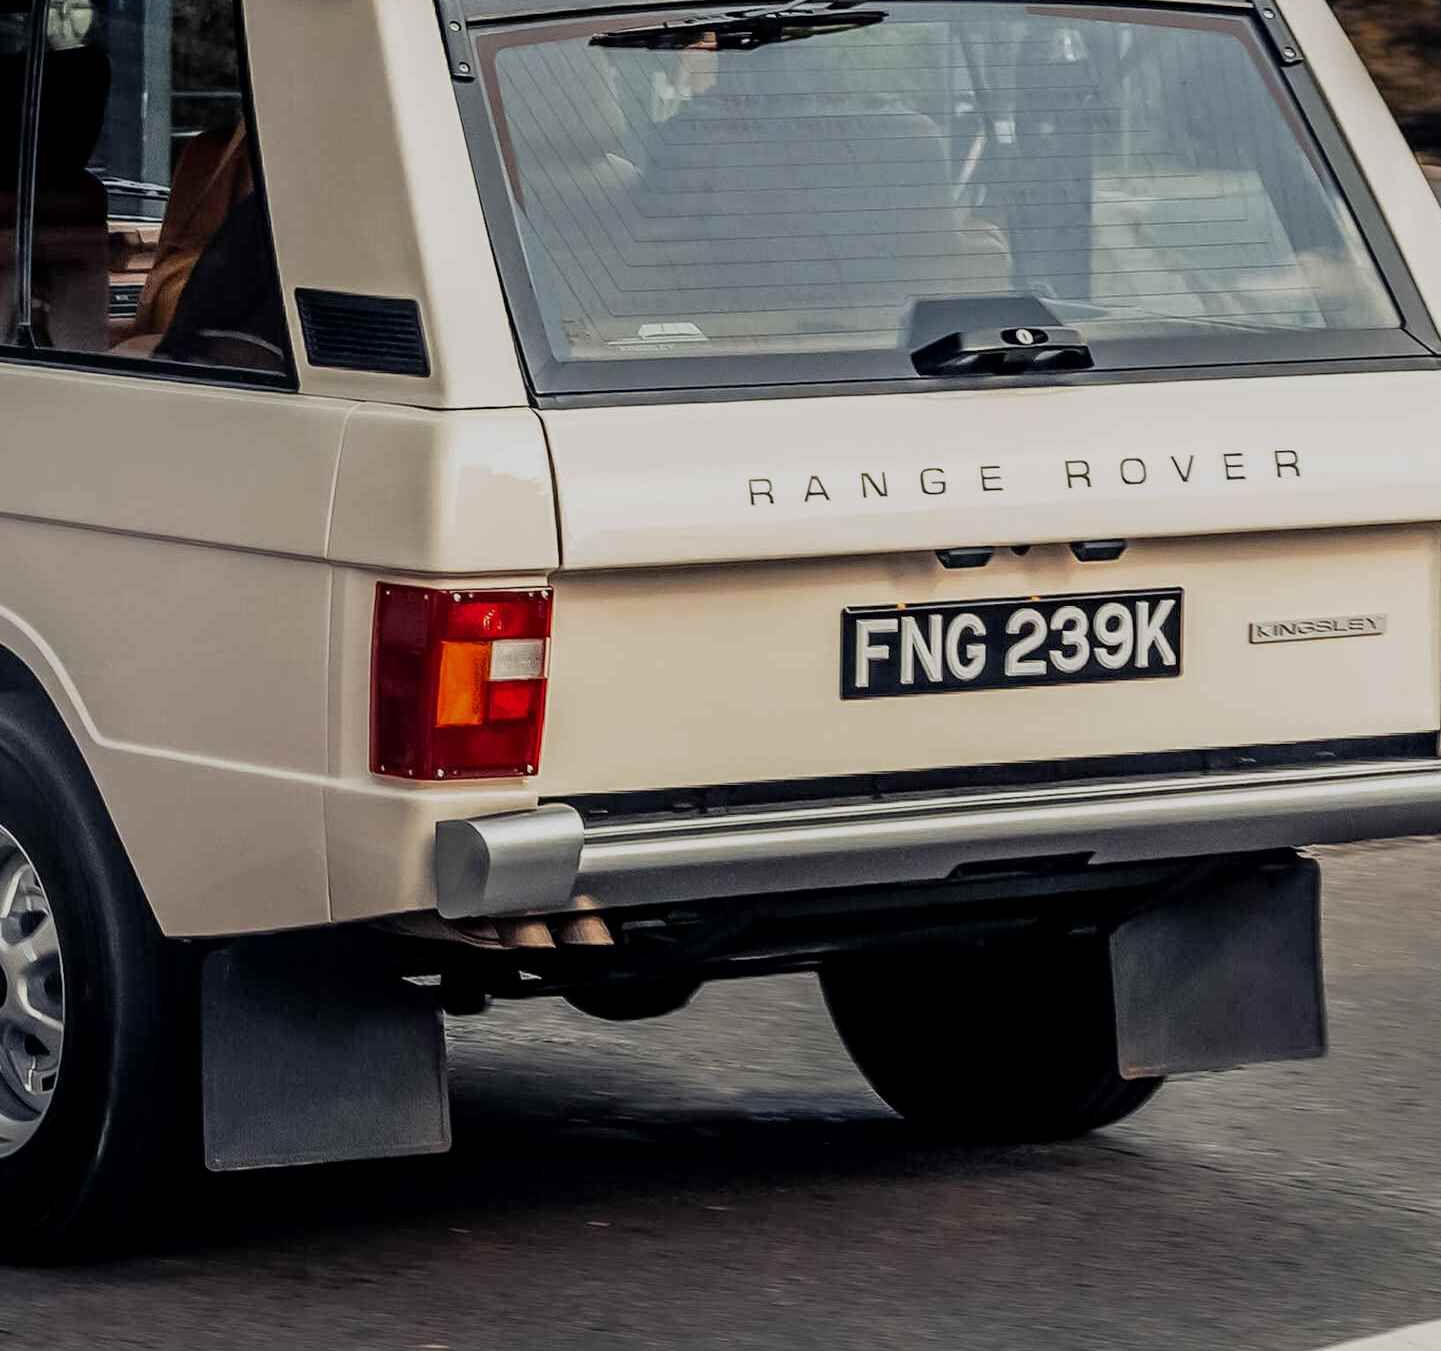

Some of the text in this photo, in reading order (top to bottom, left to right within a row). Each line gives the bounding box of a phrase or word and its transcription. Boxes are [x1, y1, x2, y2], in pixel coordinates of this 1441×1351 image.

[748, 448, 1302, 506] RANGE ROVER
[855, 599, 1177, 688] FNG 239K
